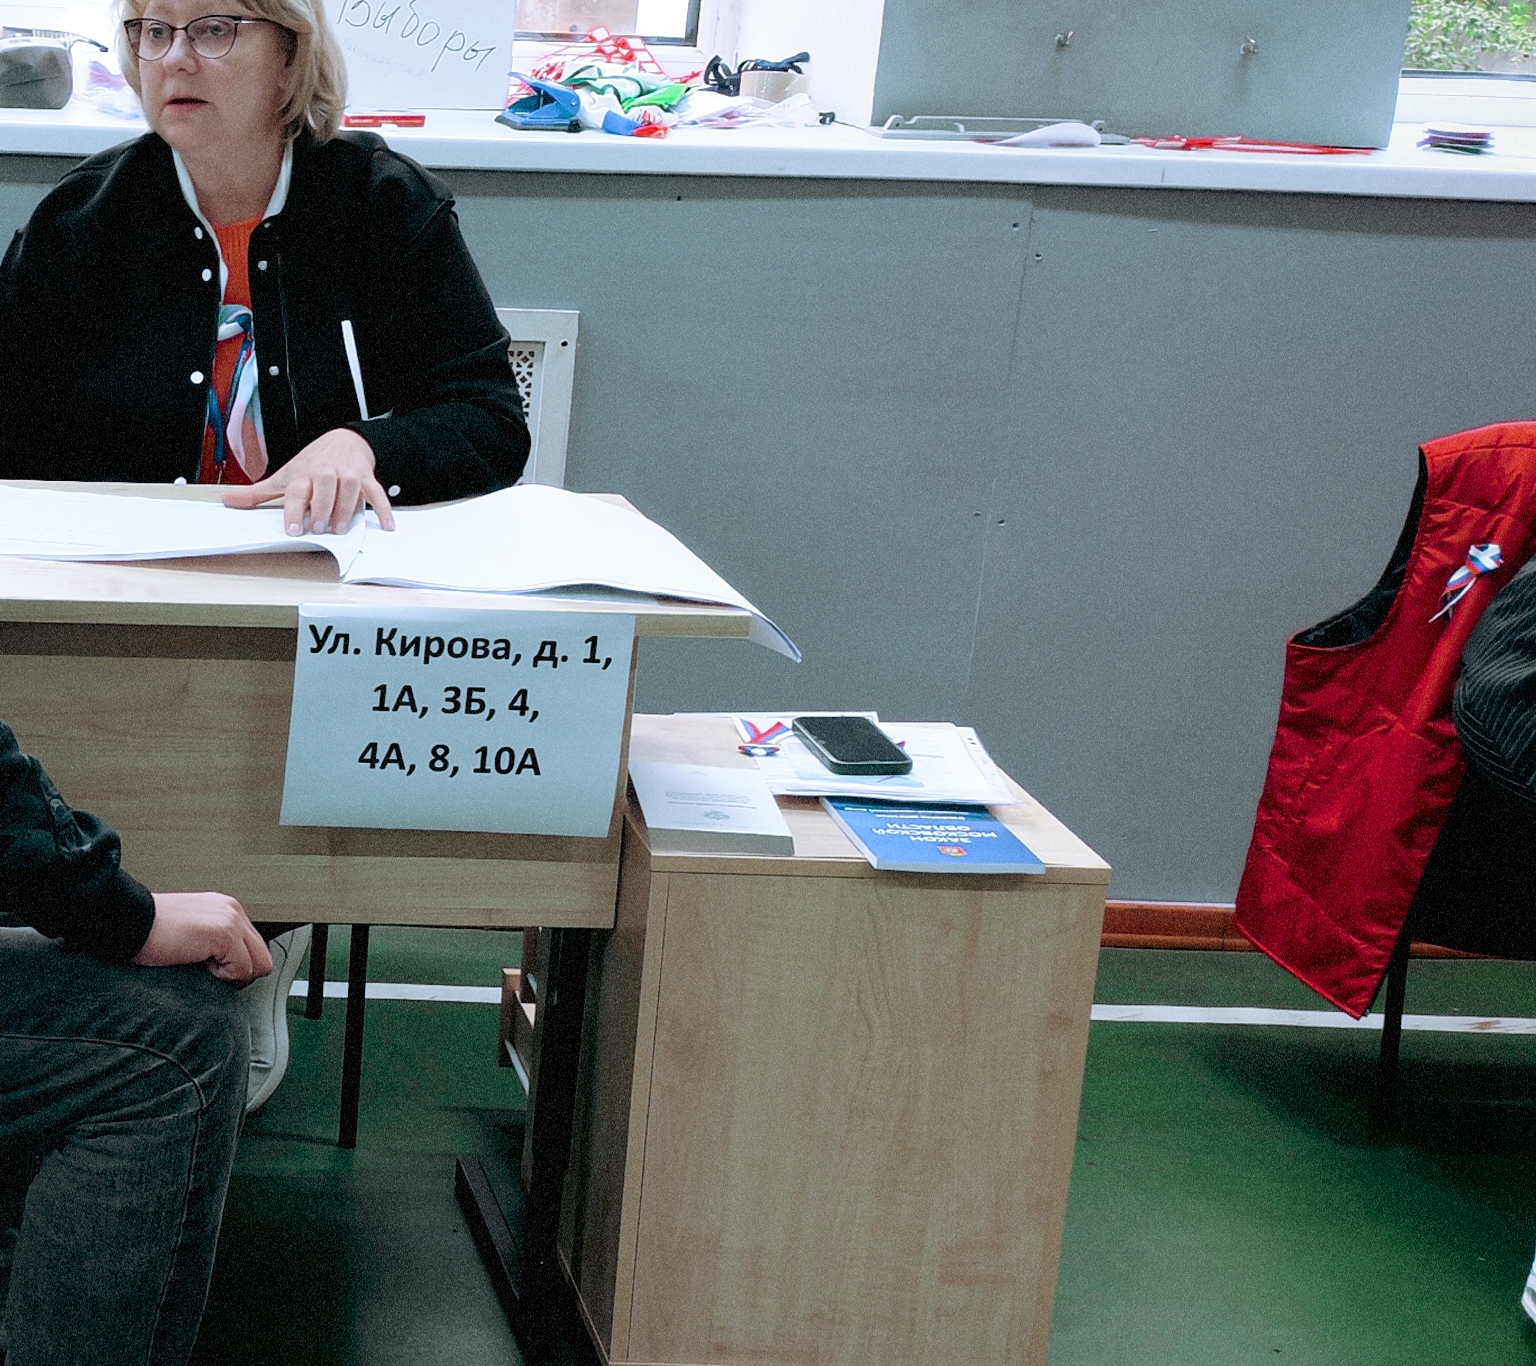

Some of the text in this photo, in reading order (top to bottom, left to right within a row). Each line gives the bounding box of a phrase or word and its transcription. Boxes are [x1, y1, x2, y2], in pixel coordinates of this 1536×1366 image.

[308, 623, 614, 671] Ул. Кирова, д. 1,
[371, 682, 541, 725] 1А, 3Б, 4,
[357, 741, 542, 779] 4А, 8, 10А
[872, 827, 998, 838] МОСКОВСКОЙ
